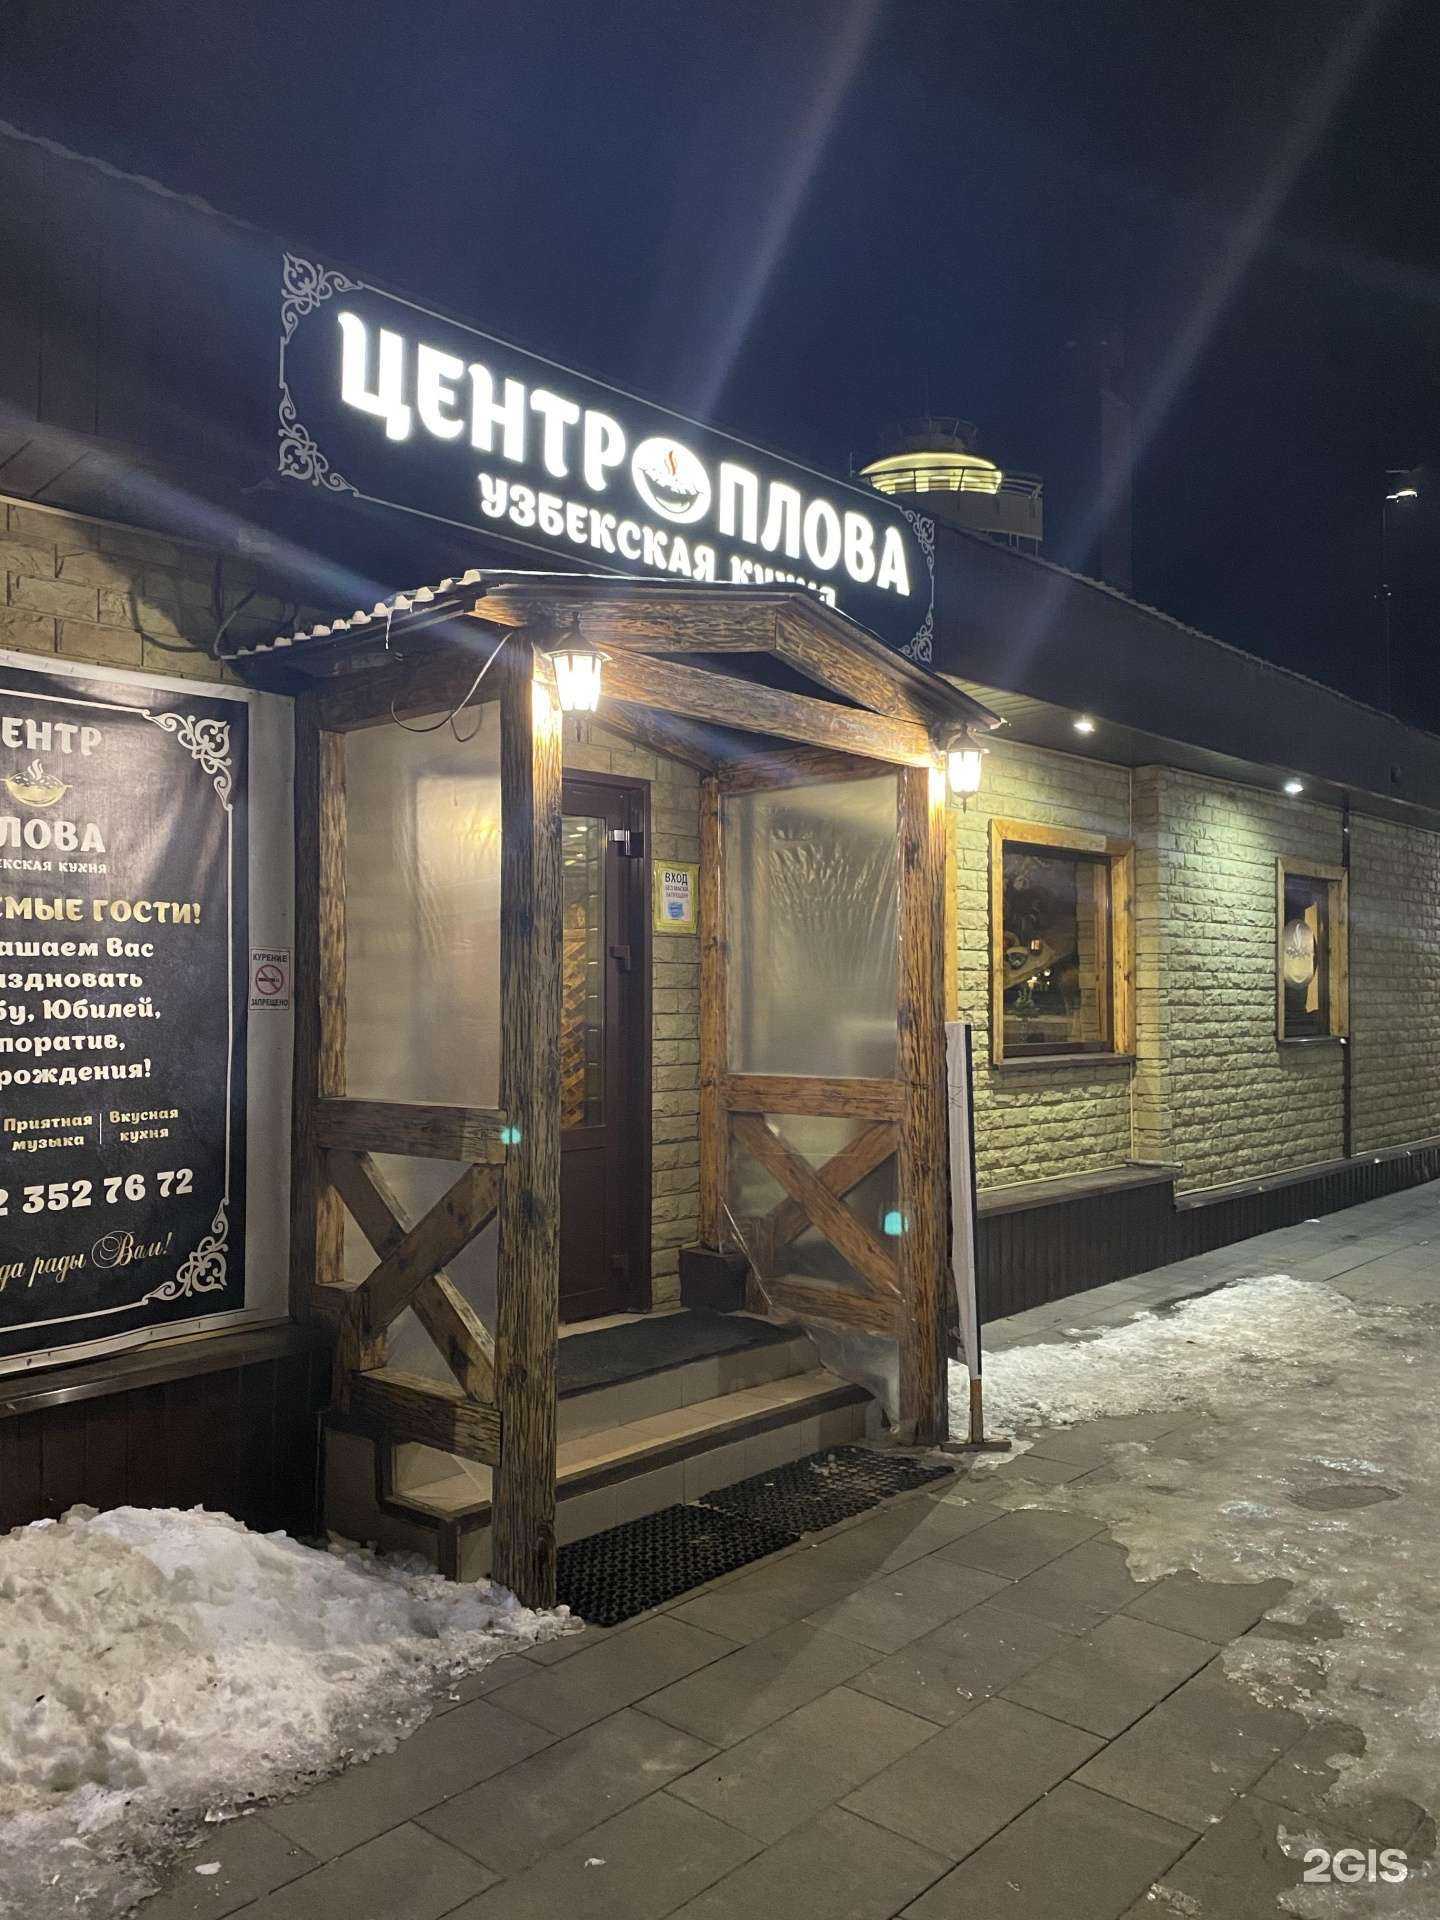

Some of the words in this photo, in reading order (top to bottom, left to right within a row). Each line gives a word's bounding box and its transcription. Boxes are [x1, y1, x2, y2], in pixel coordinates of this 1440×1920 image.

[337, 311, 626, 492] ЦЕНТР
[718, 461, 911, 597] ПЛОВА
[478, 473, 716, 581] УЗБЕКСКАЯ
[1, 716, 102, 756] ЕНТР
[58, 861, 107, 874] КУХНЯ
[665, 872, 687, 886] ВХОД
[0, 896, 84, 921] МЫЕ
[93, 899, 201, 924] ГОСТИ!
[106, 937, 154, 957] Вас
[253, 953, 288, 963] КУРЕНИЕ
[42, 997, 161, 1020] Юбилей,
[4, 1115, 93, 1133] Приятная
[110, 1108, 179, 1124] Вкусная
[12, 1135, 85, 1153] музыка
[120, 1128, 169, 1144] кухня
[22, 1179, 93, 1214] 352
[103, 1173, 146, 1204] 76
[157, 1168, 193, 1198] 72
[27, 1253, 87, 1288] рады
[91, 1230, 173, 1269] Вам!
